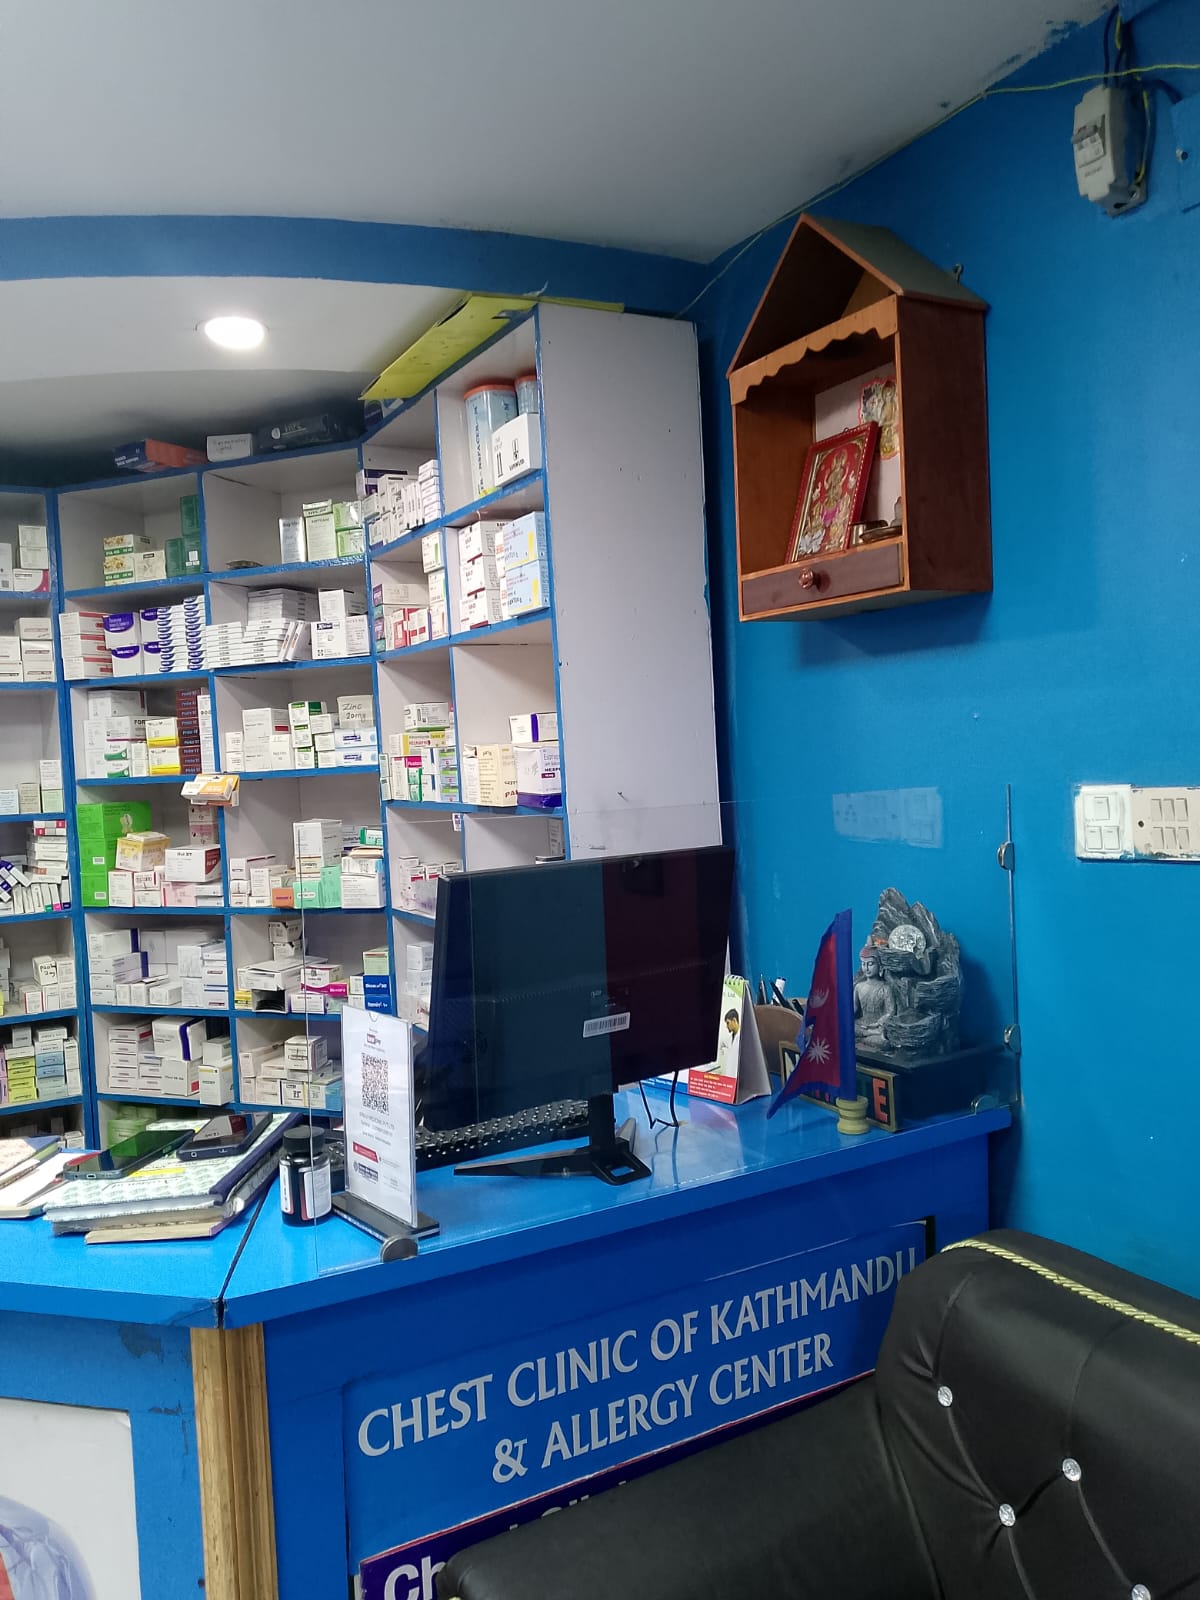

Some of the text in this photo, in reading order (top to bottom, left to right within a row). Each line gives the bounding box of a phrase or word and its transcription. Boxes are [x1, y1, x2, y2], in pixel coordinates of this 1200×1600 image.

[358, 1247, 916, 1457] CHEST CLINIC OF KATHMANDU
[492, 1333, 834, 1483] & ALLERGY CENTER
